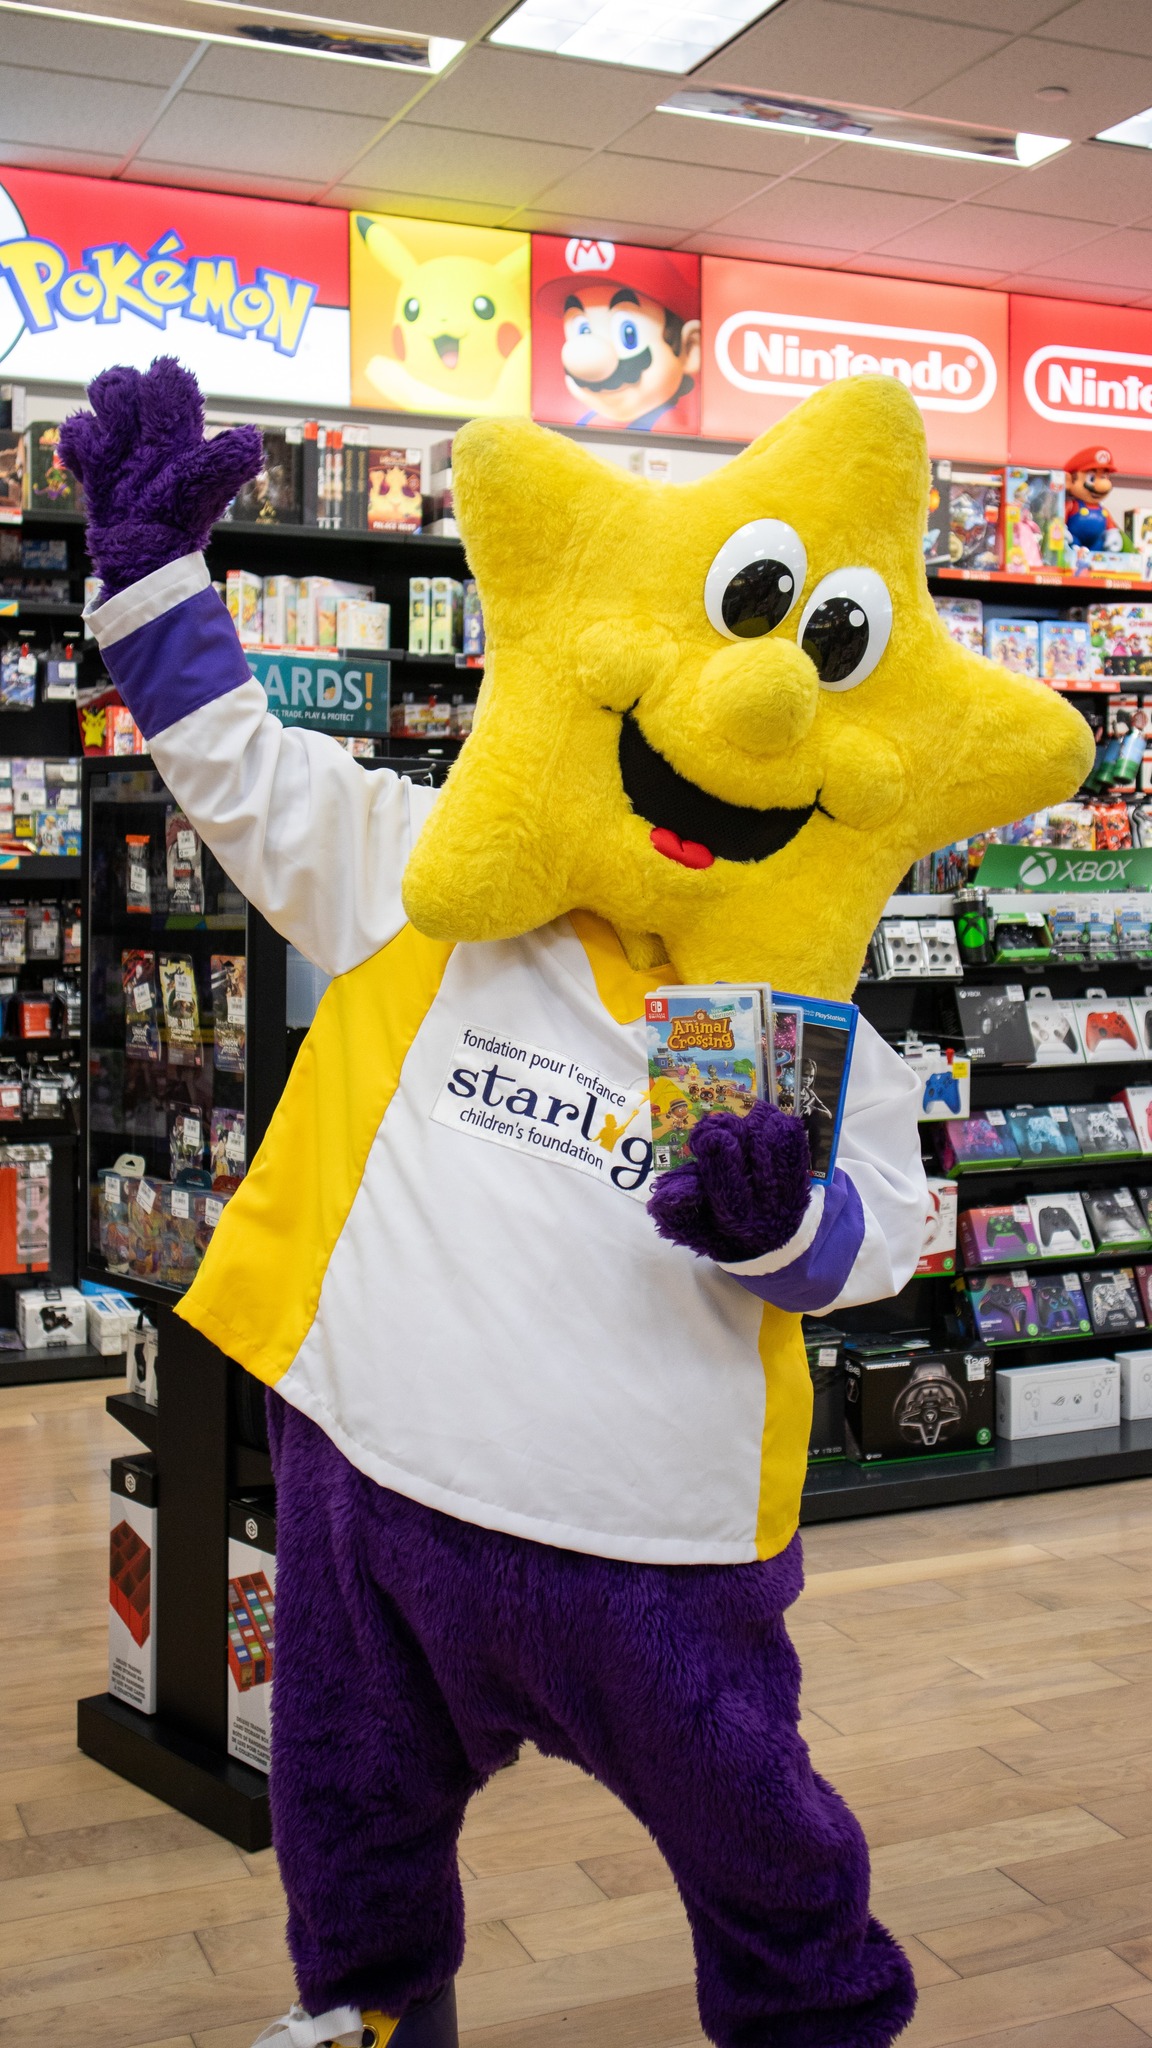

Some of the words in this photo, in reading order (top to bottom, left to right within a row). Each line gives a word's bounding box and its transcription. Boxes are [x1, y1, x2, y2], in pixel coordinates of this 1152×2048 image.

[744, 330, 972, 394] Nintendo
[281, 709, 303, 719] TRADE,
[304, 711, 320, 720] PLAY
[327, 713, 354, 721] PROTECT
[1057, 859, 1133, 882] XBOX
[814, 1011, 846, 1022] PlayStation
[674, 1019, 728, 1035] Animal
[668, 1033, 734, 1049] Crossing
[463, 1029, 527, 1062] fondation
[529, 1053, 566, 1074] pour
[568, 1064, 626, 1107] l'enfance
[460, 1108, 524, 1139] children's
[528, 1126, 603, 1170] foundation
[658, 1153, 668, 1164] E
